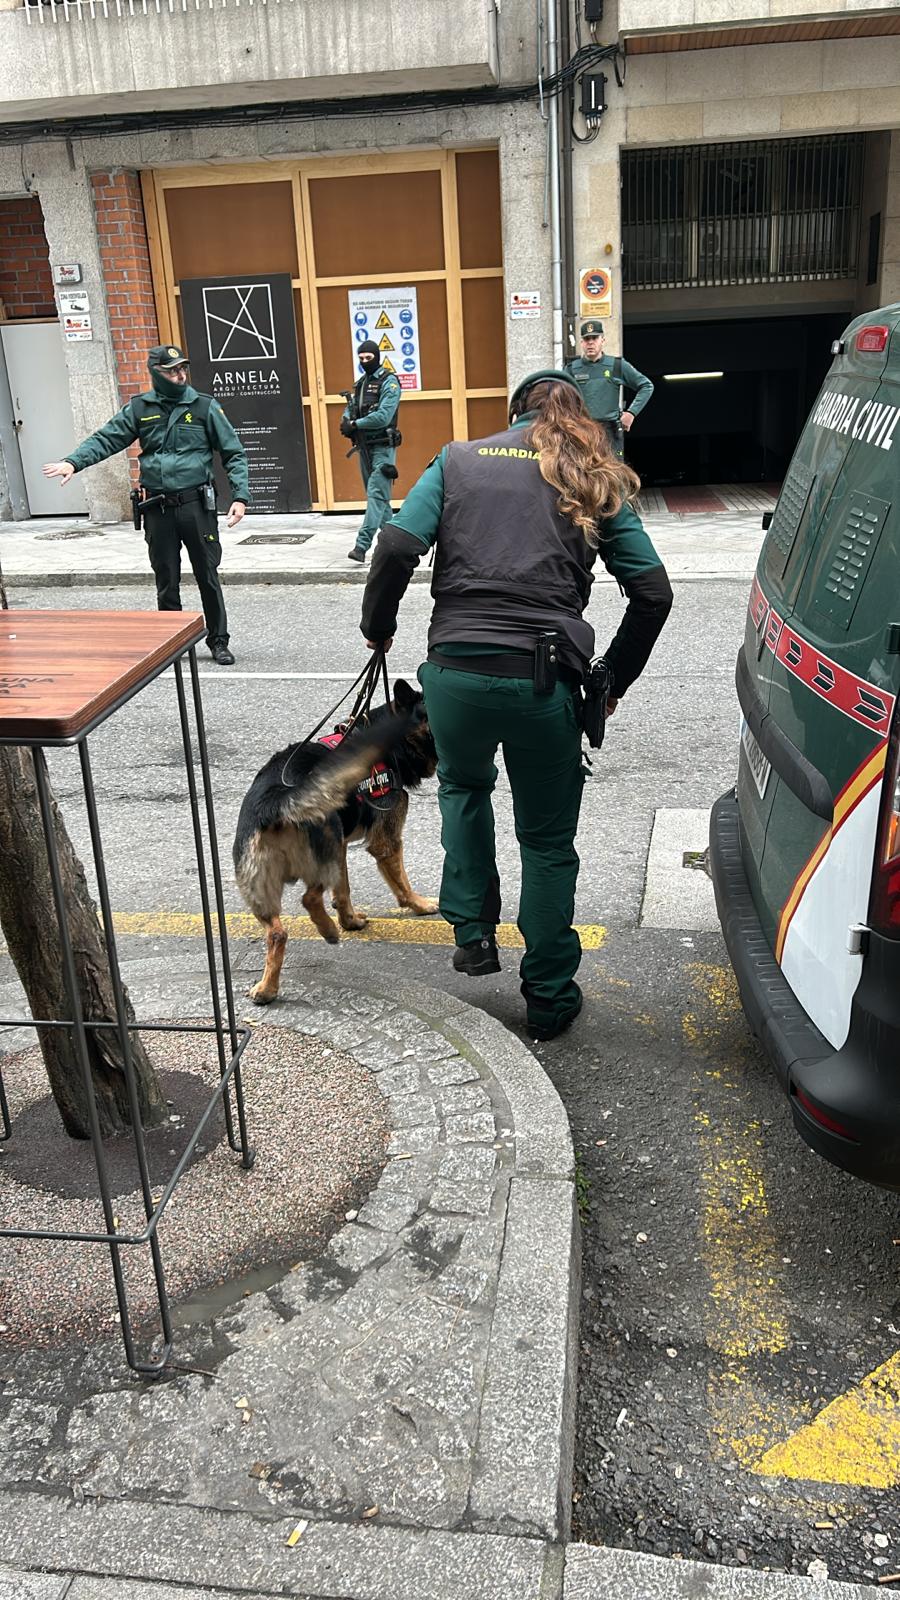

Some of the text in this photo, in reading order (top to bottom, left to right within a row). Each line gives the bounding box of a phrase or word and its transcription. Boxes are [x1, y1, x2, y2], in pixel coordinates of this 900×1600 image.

[212, 369, 280, 385] ARNELA
[213, 384, 280, 392] ARQUITECTURA
[813, 391, 900, 451] GUARDIA CIVIL
[478, 447, 542, 461] GUARDIA
